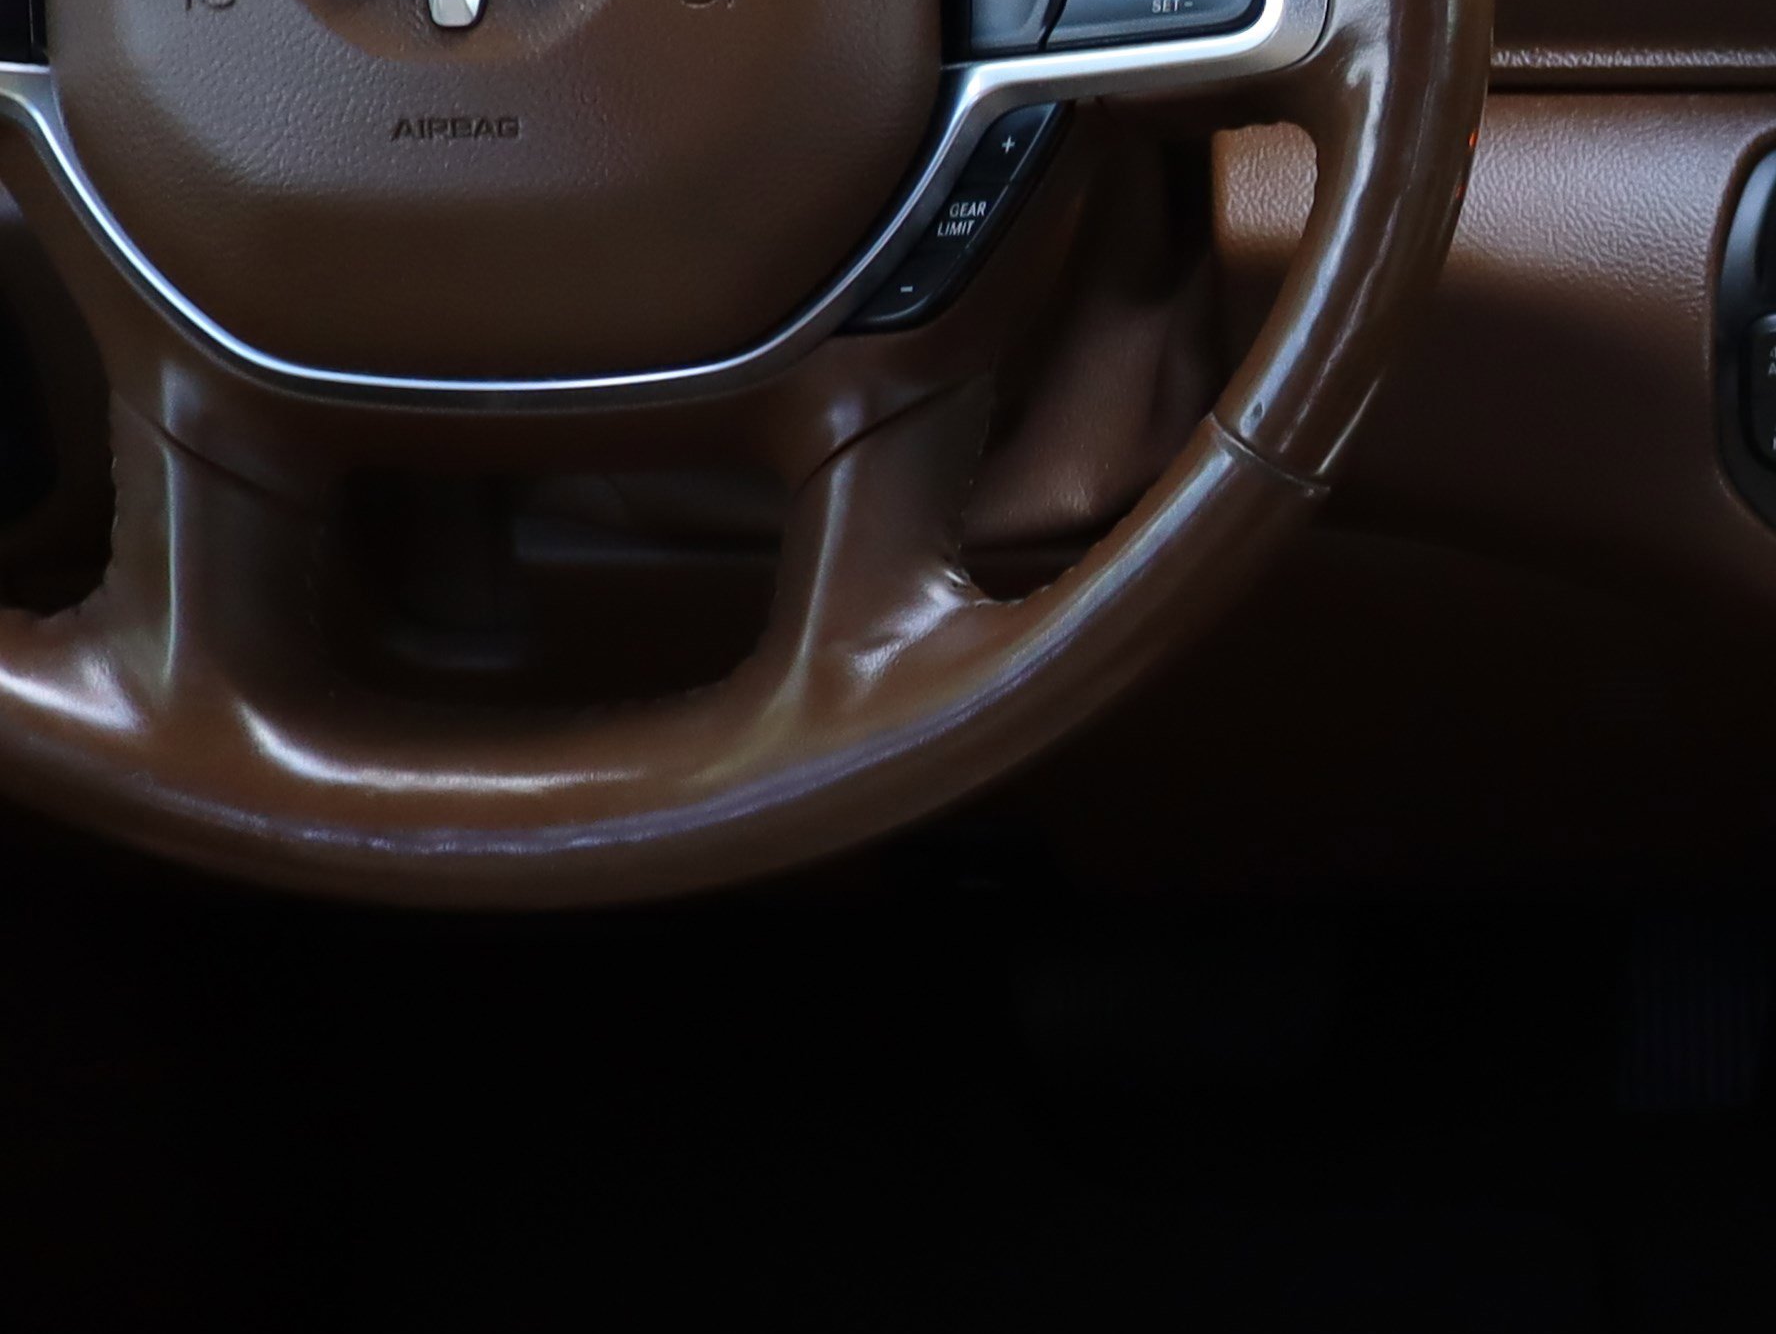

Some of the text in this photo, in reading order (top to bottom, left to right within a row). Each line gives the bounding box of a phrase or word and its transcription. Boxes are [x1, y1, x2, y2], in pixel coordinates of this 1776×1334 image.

[390, 116, 520, 141] AIRBAG
[949, 201, 987, 219] GEAR
[936, 218, 975, 237] LIMIT
